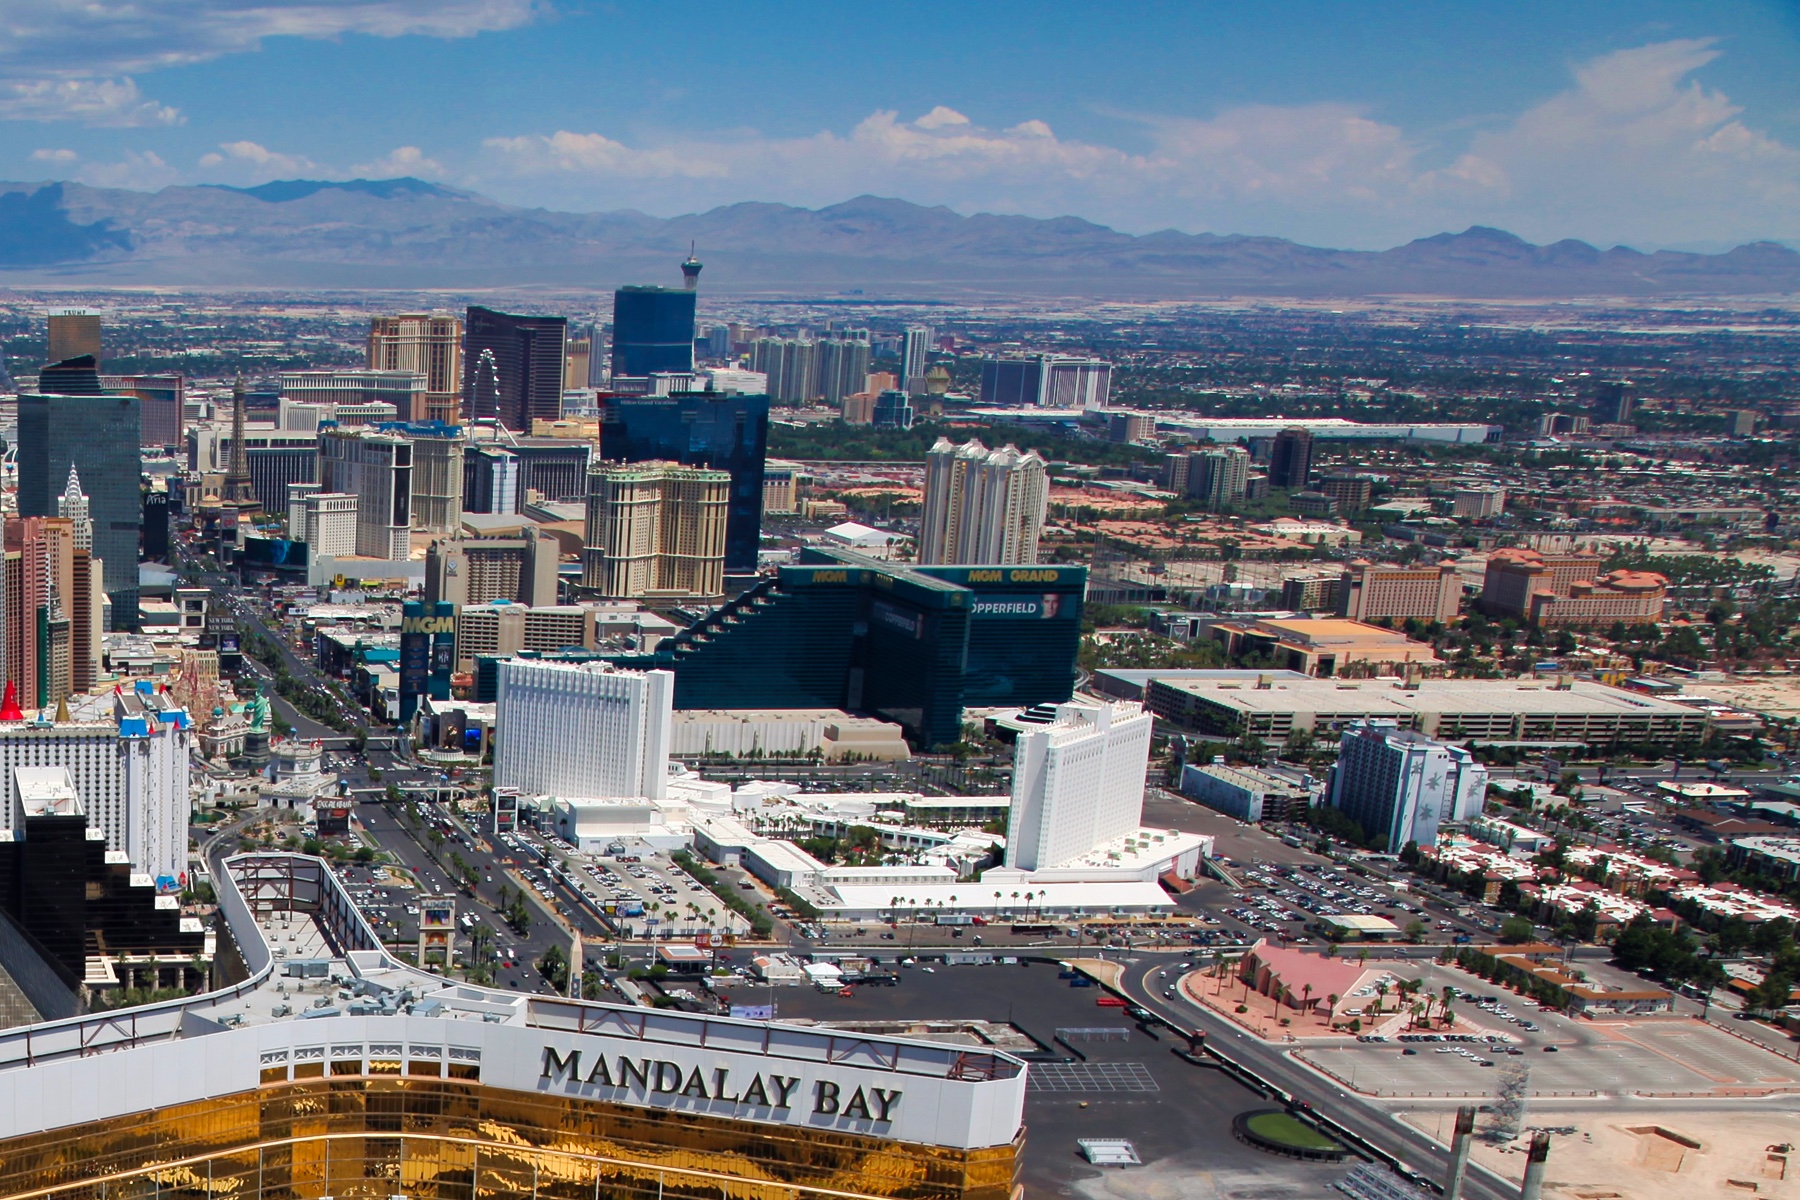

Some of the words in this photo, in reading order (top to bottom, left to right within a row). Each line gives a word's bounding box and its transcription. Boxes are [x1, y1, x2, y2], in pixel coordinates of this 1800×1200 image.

[146, 493, 167, 505] Aria
[812, 570, 848, 582] MGM
[968, 569, 1003, 582] MGM
[1010, 569, 1059, 582] GRAND
[402, 616, 454, 634] MGM
[317, 800, 352, 809] EXCALIBUR
[540, 1045, 801, 1110] MANDALAY
[812, 1079, 903, 1123] BAY
